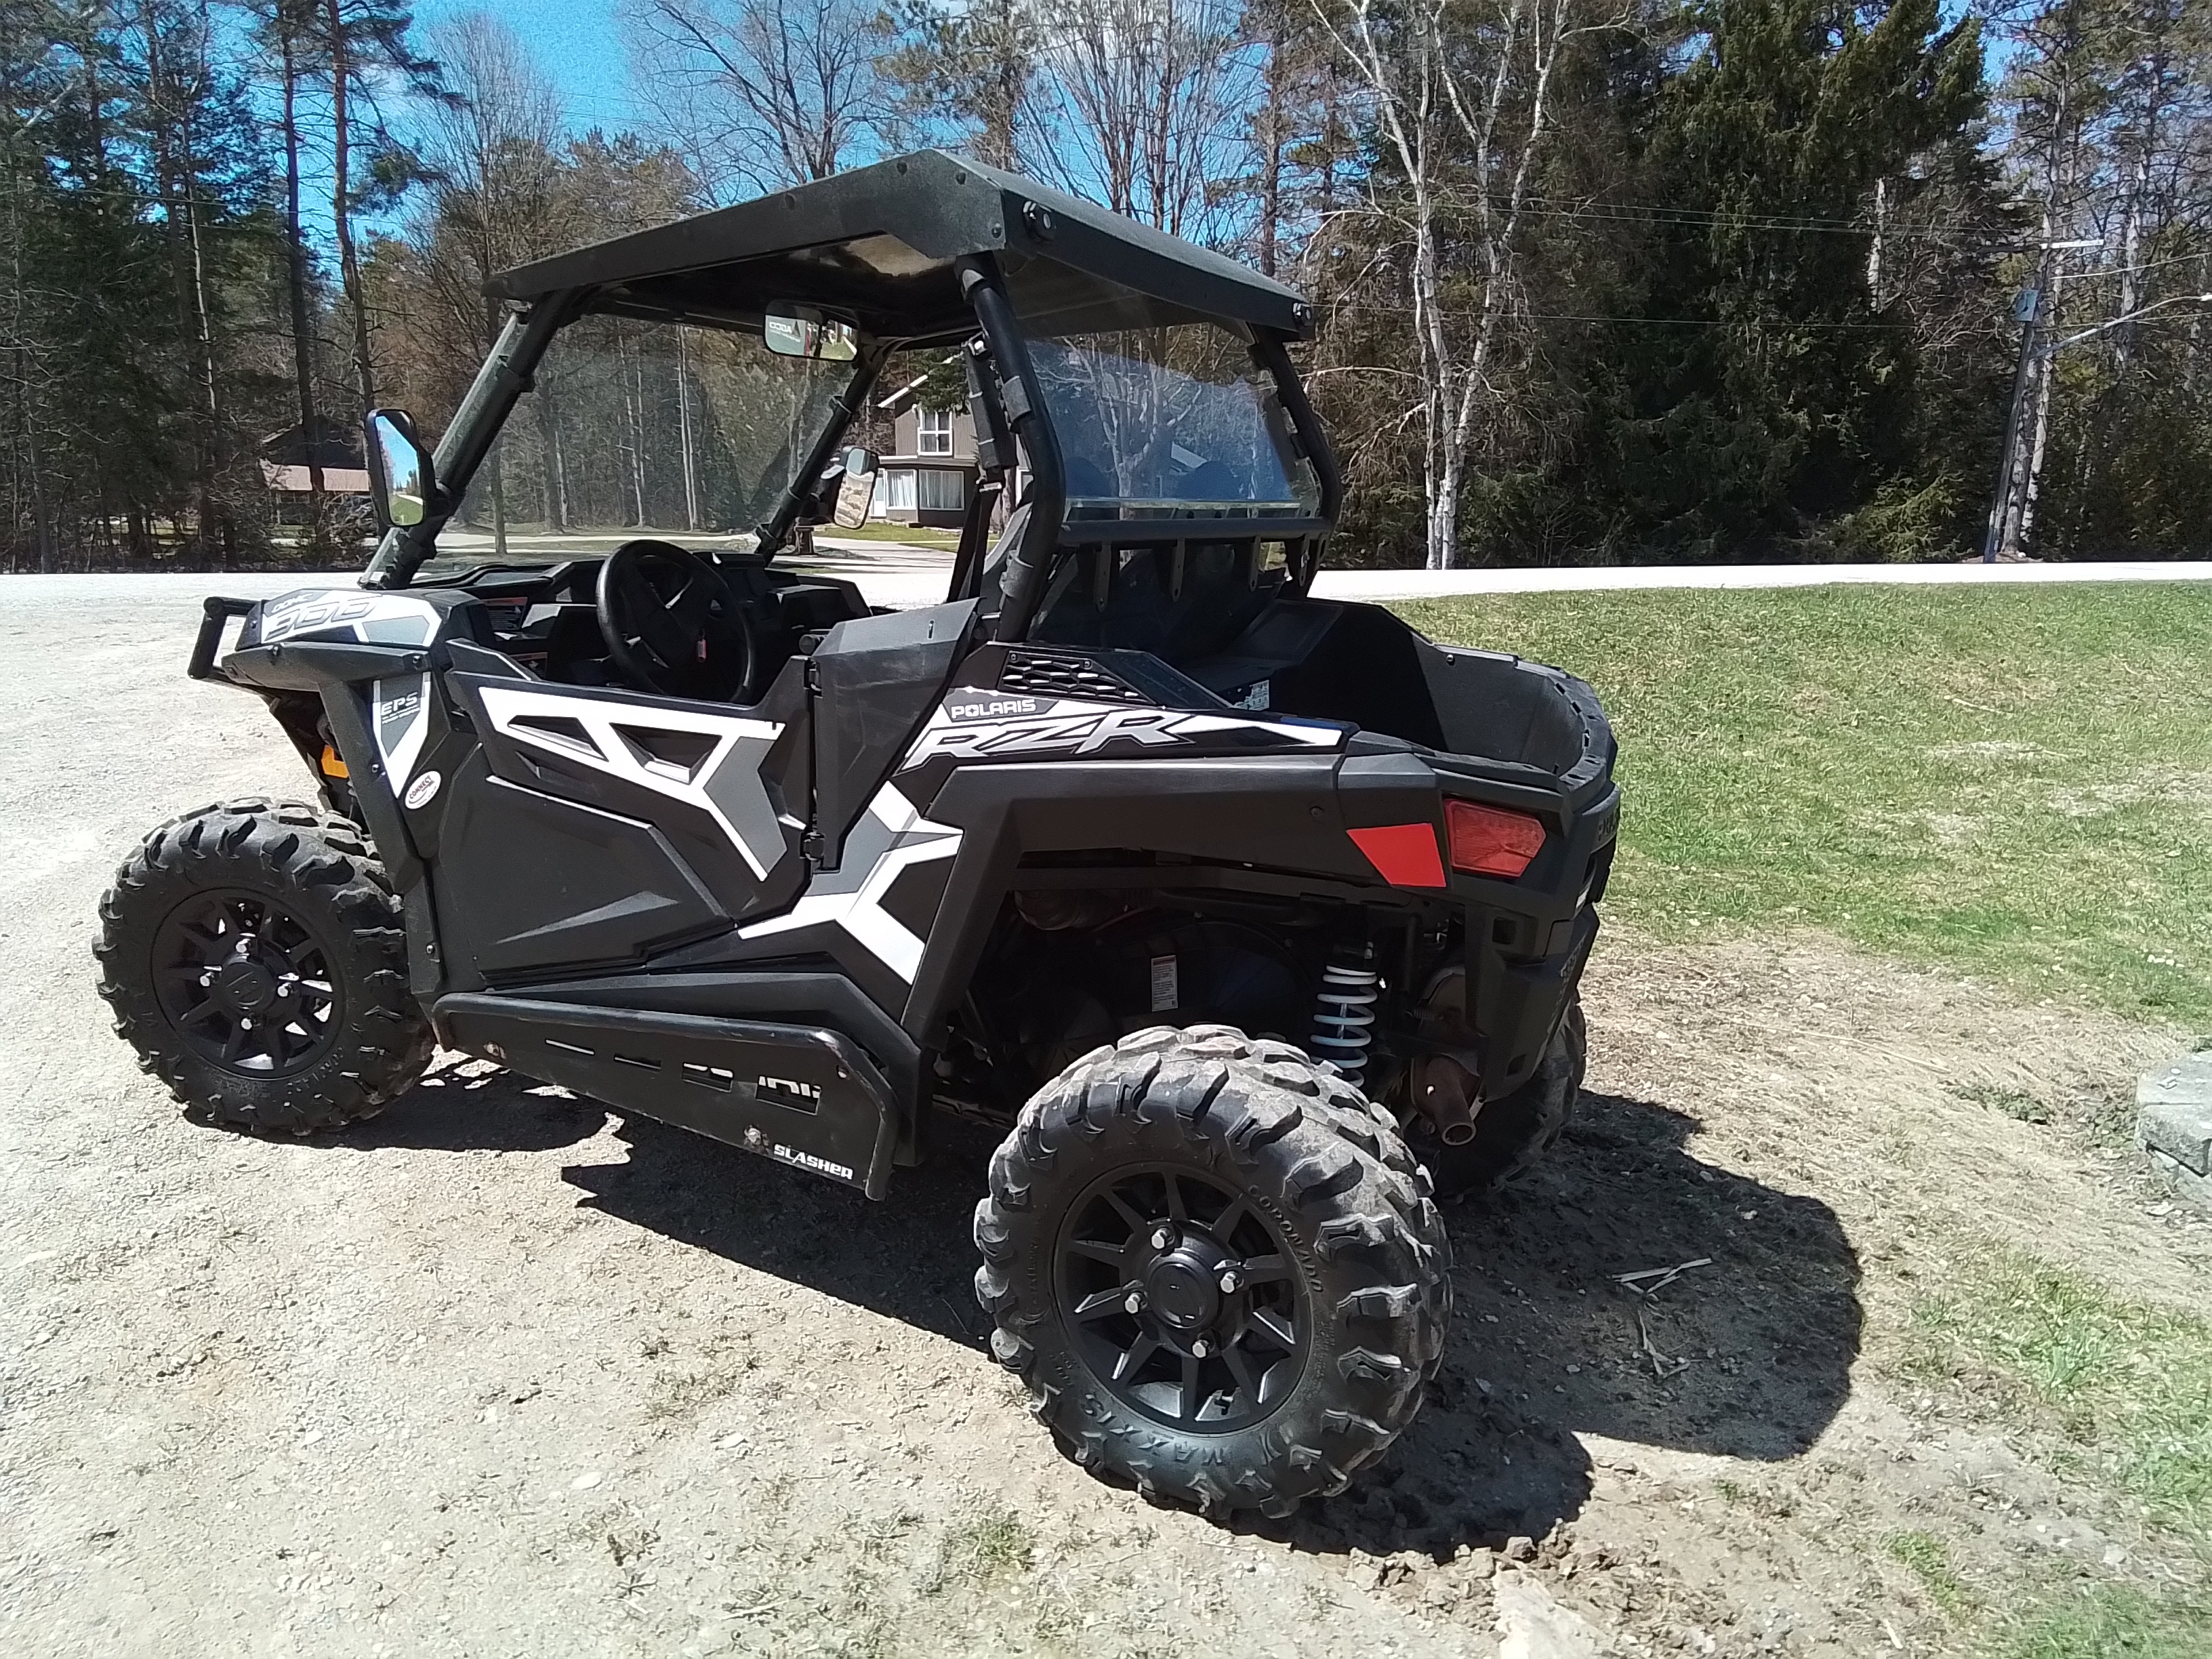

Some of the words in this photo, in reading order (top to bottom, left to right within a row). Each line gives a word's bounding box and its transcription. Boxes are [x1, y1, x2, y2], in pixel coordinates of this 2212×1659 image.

[381, 691, 418, 716] EPS
[951, 699, 1036, 719] POLARIS
[893, 709, 1195, 777] RZR
[1248, 1184, 1323, 1292] CORONADO
[1081, 1392, 1233, 1467] MAXXIS
